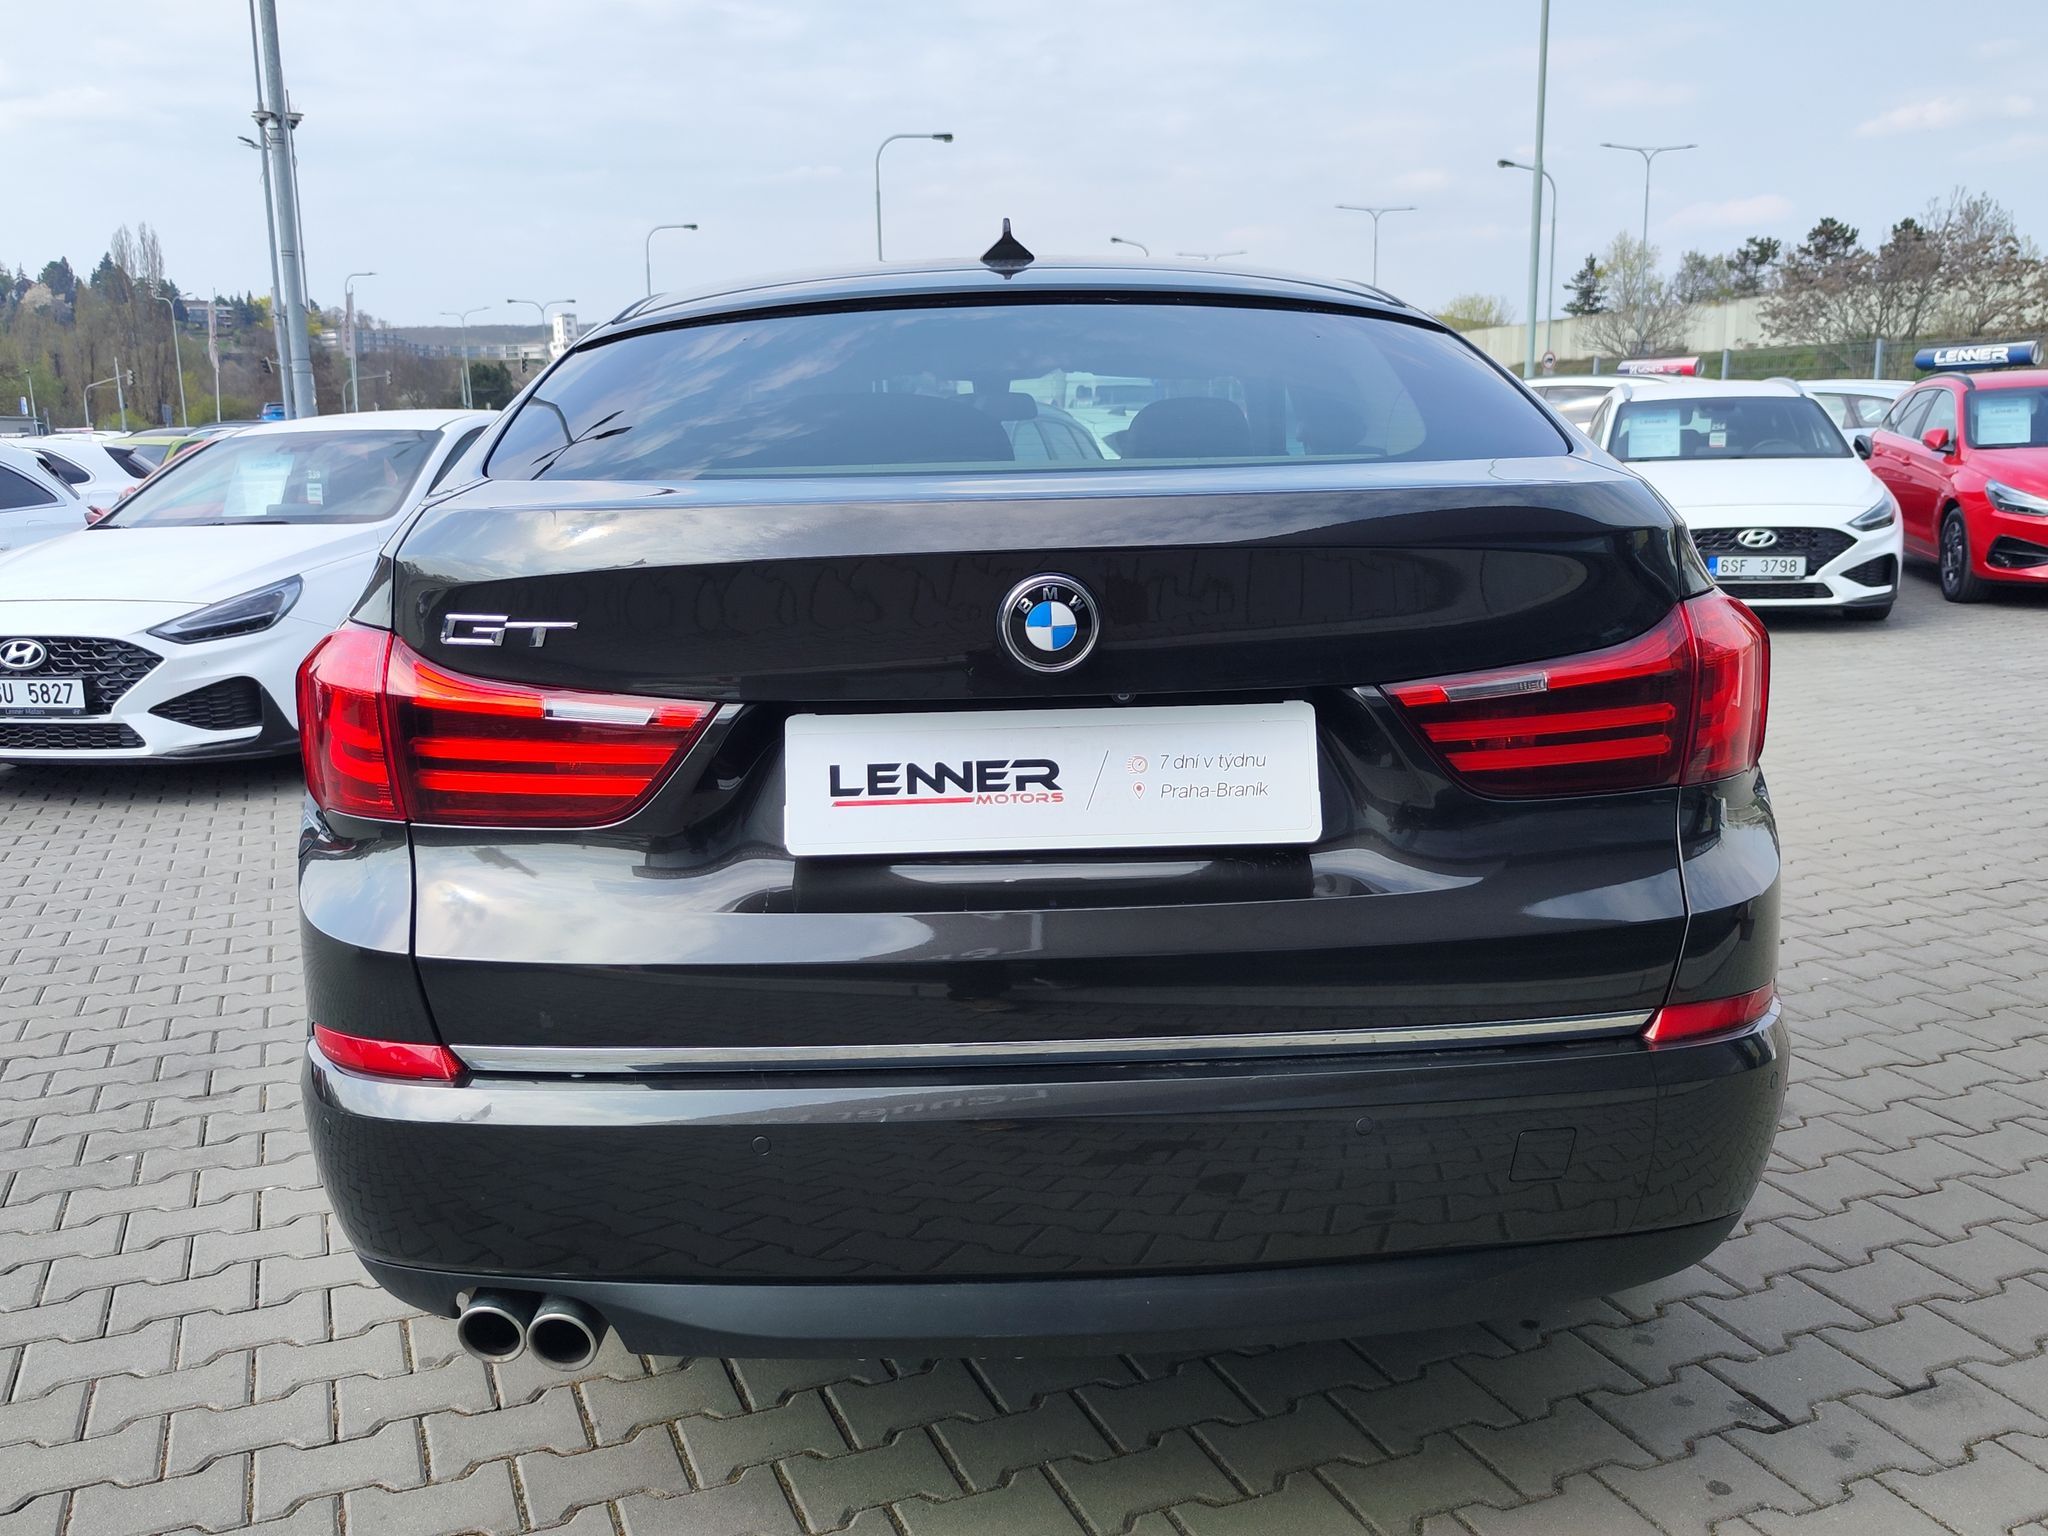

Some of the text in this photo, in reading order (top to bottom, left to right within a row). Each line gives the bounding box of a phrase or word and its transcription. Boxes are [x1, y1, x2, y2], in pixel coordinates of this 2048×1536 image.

[1934, 346, 2010, 363] LENNER
[1720, 559, 1747, 573] 6SF
[1760, 559, 1797, 573] 3798
[1016, 586, 1086, 615] BMW
[440, 613, 579, 648] GT
[0, 682, 73, 704] U 5827
[1160, 752, 1267, 772] 7 dní v týdnu
[829, 759, 1063, 797] LENNER
[975, 792, 1064, 805] MOTORS
[1160, 780, 1269, 799] Praha-Braník
